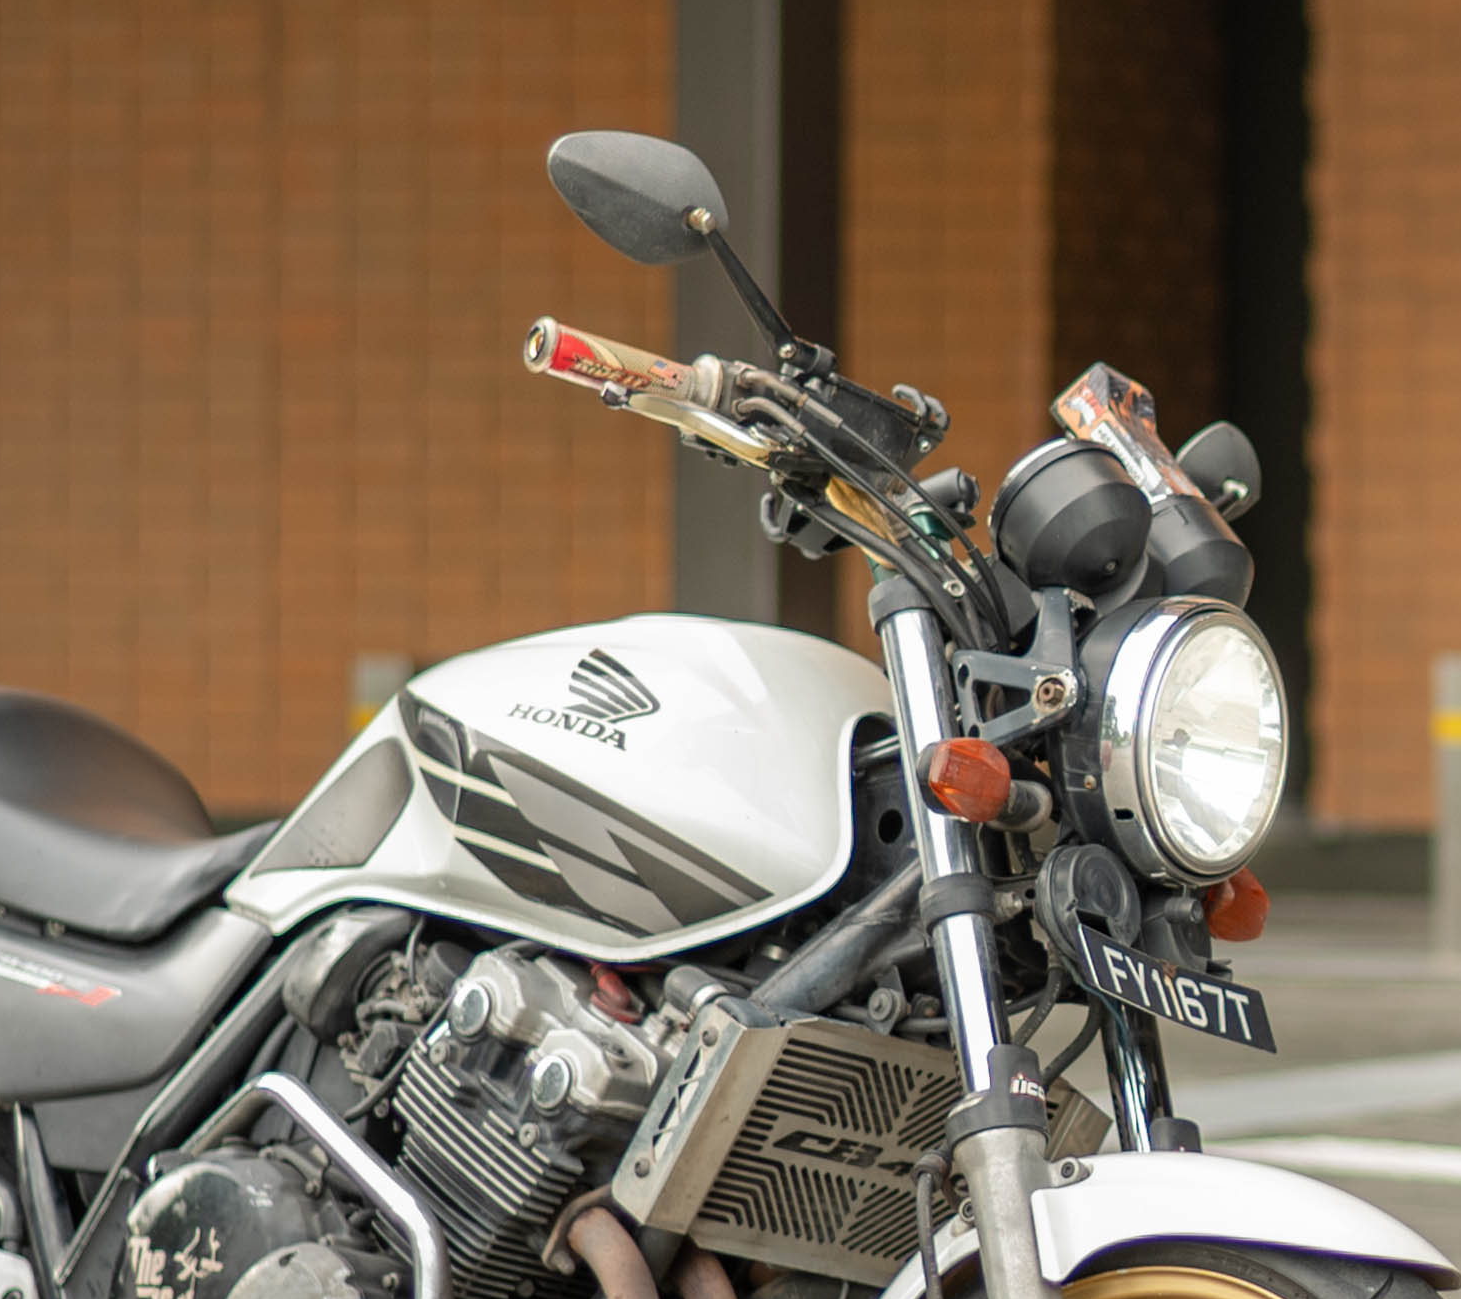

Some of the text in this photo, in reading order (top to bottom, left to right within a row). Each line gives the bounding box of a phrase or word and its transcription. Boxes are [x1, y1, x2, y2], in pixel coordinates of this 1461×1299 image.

[507, 703, 627, 751] HONDA
[1102, 945, 1252, 1041] FY1167T
[128, 1235, 167, 1286] The
